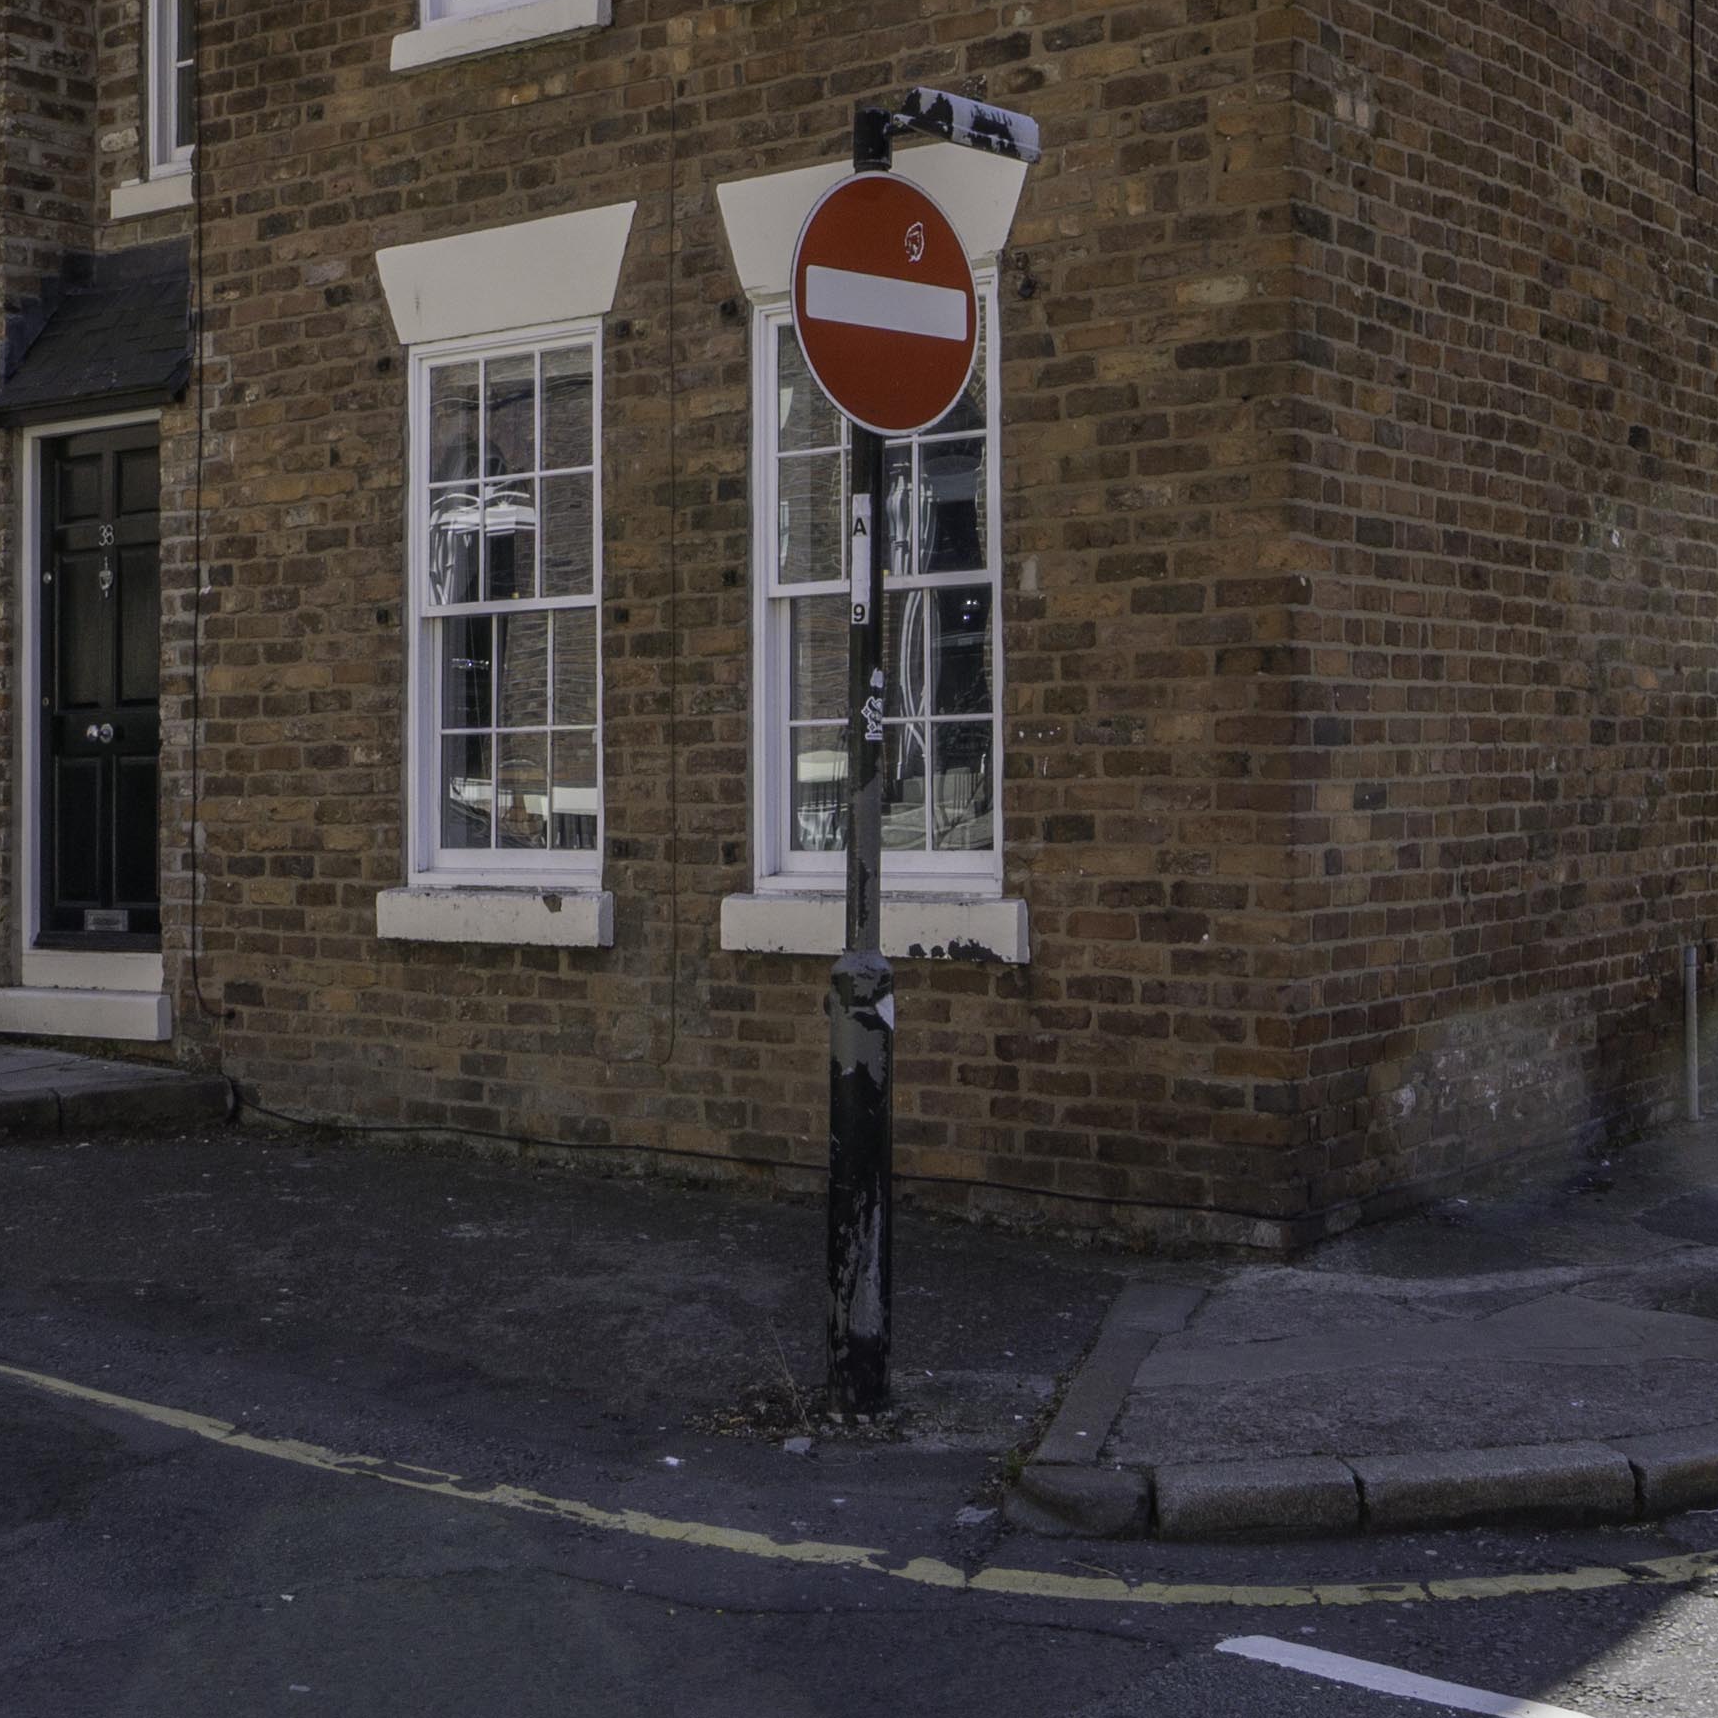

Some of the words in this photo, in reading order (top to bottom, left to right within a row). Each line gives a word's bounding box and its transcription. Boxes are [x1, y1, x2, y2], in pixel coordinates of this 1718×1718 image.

[98, 524, 115, 547] 38
[853, 517, 868, 536] A
[853, 603, 866, 623] 9
